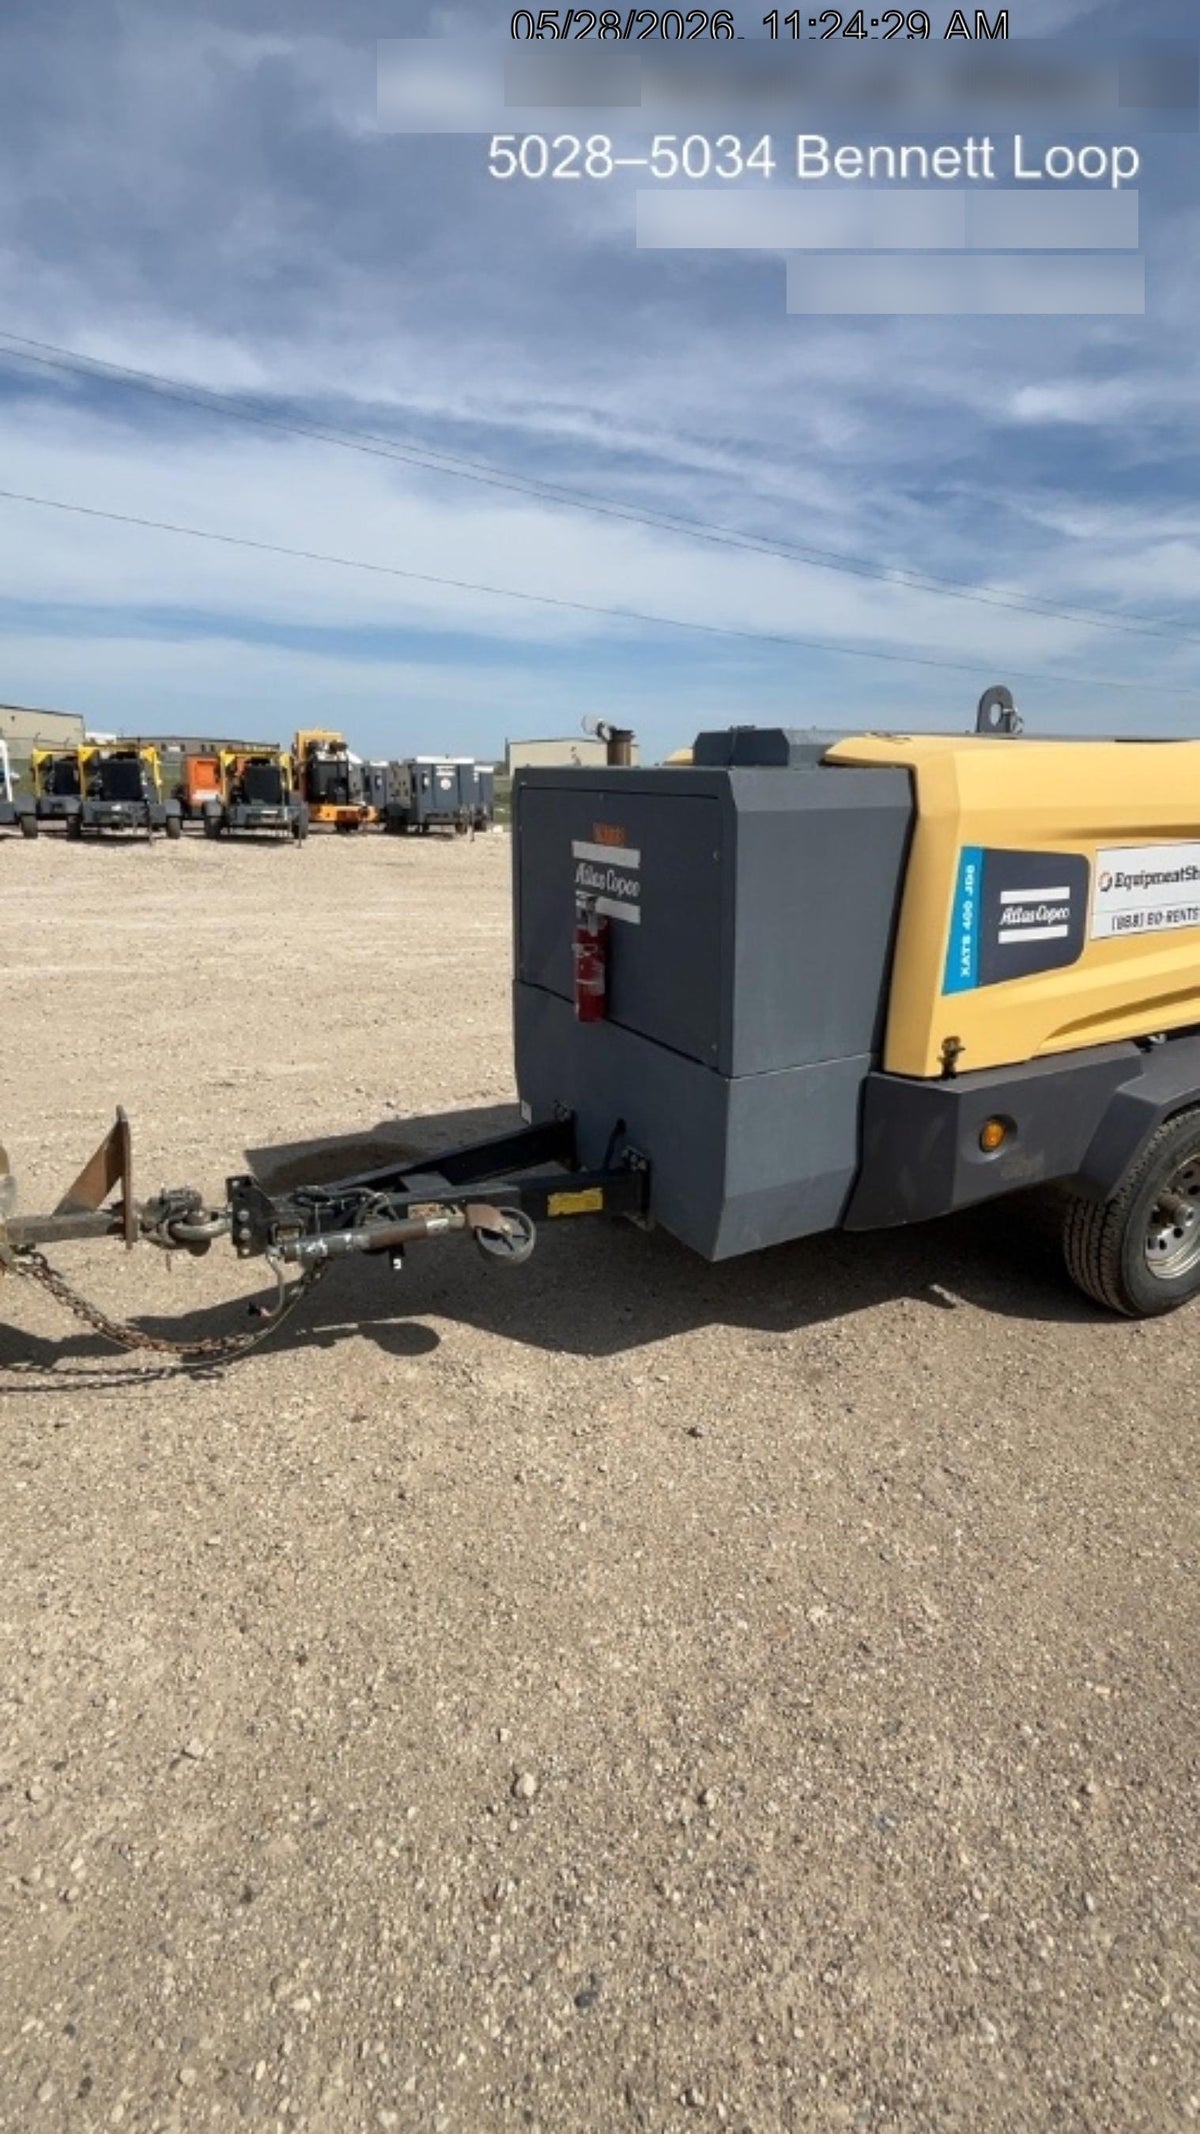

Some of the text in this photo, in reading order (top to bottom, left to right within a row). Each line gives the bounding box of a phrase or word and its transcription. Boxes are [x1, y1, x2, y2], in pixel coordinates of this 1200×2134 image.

[574, 862, 640, 897] Atlas Copco
[963, 900, 973, 930] 400
[999, 905, 1069, 925] Atlas Copco
